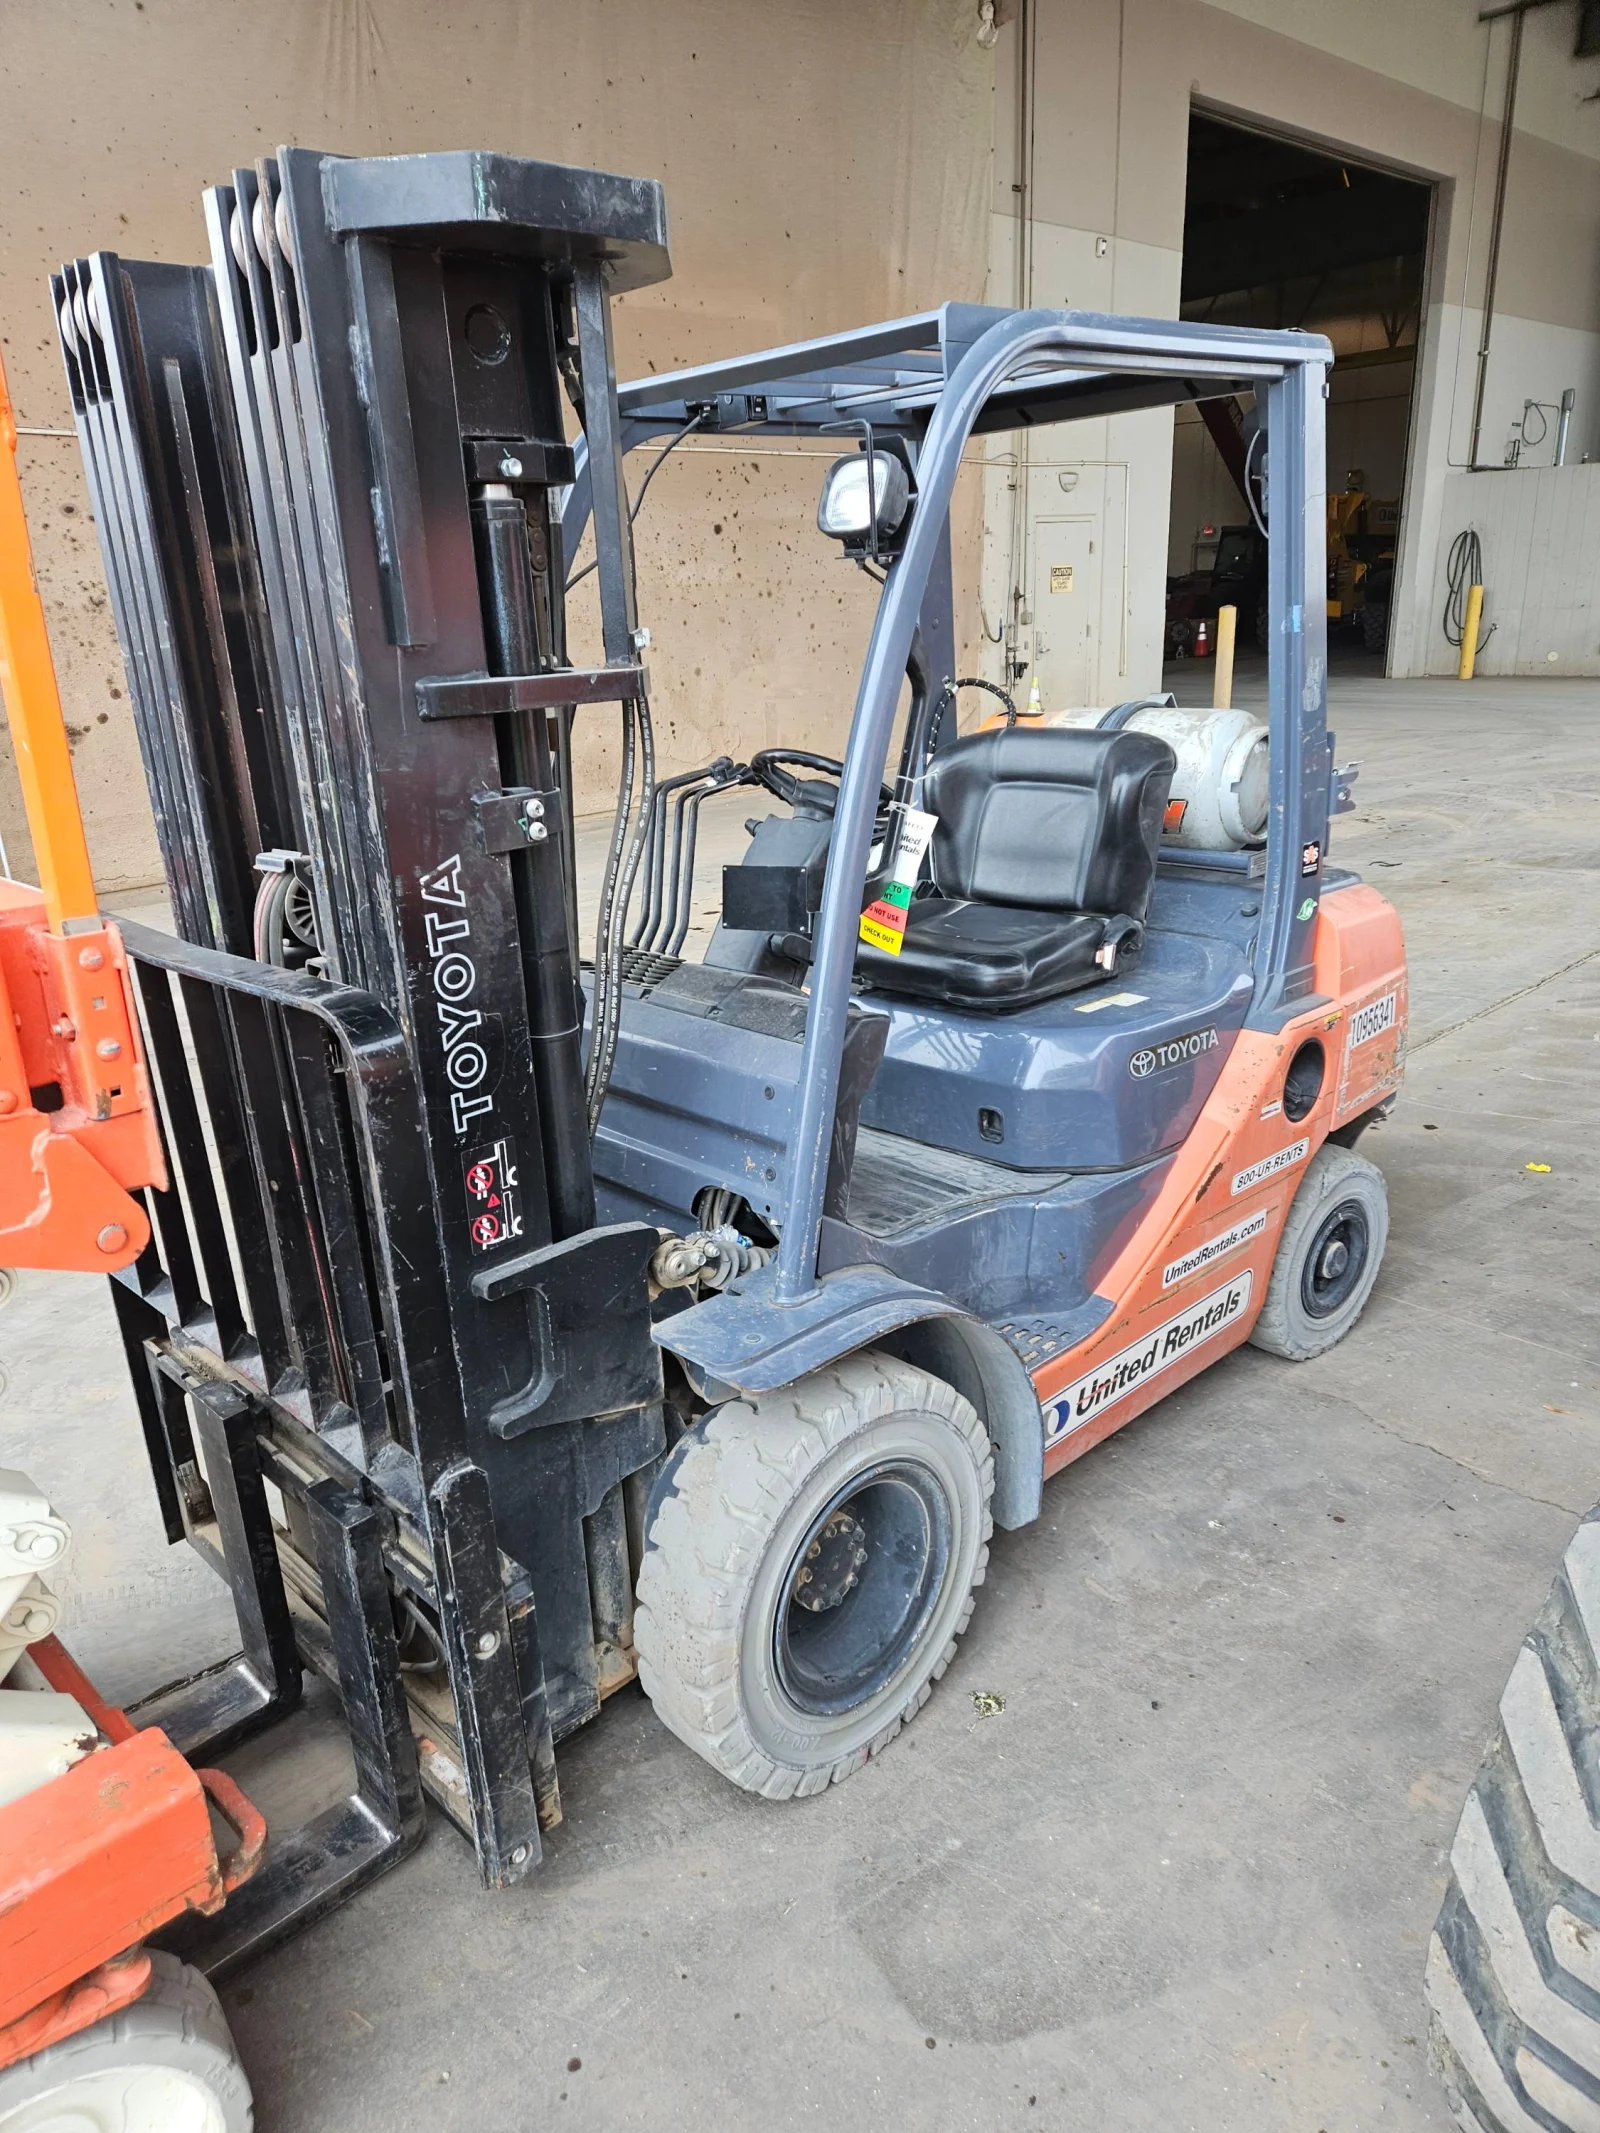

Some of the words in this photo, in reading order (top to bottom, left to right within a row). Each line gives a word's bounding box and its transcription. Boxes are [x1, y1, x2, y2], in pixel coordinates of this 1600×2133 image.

[864, 925, 881, 938] CHECK
[882, 934, 894, 944] OUT
[874, 907, 886, 917] NOT
[887, 912, 899, 922] USE
[419, 853, 493, 1134] TOYOTA
[1352, 997, 1394, 1046] 10956341
[1157, 1029, 1219, 1066] TOYOTA
[1237, 1143, 1304, 1189] 800-UR-RENTS
[1165, 1217, 1265, 1284] UnitedRentals.com
[1076, 1338, 1159, 1416] United
[1162, 1290, 1241, 1360] Rentals
